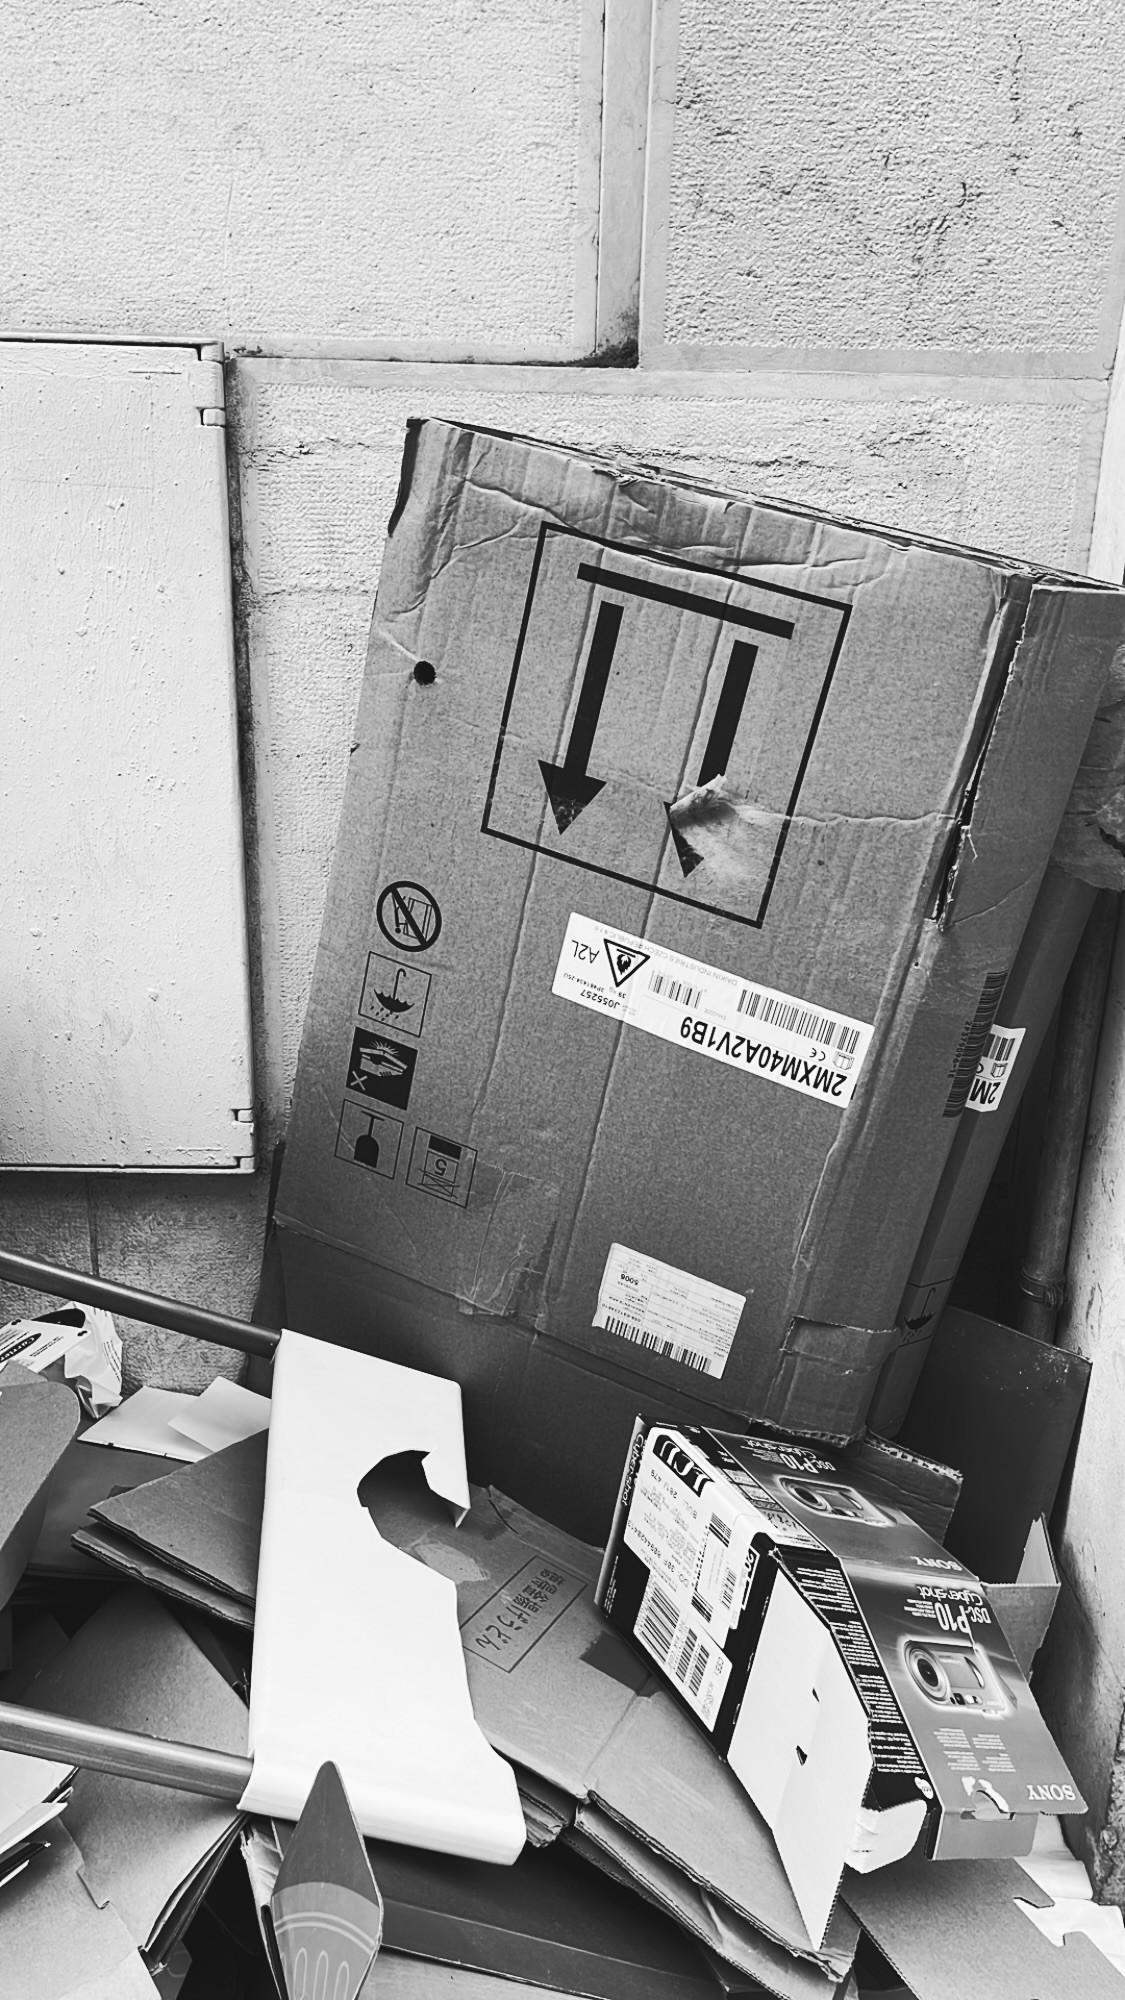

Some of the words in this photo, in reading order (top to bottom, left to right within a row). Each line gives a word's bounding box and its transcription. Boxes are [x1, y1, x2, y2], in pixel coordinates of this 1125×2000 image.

[571, 939, 600, 964] A2L
[580, 988, 621, 1009] J055257
[680, 1016, 848, 1097] 2MXM40A2V1B9
[434, 1158, 448, 1177] 5
[909, 1556, 963, 1571] SONY
[934, 1602, 992, 1634] DSC-P10
[1026, 1784, 1077, 1802] SONY
